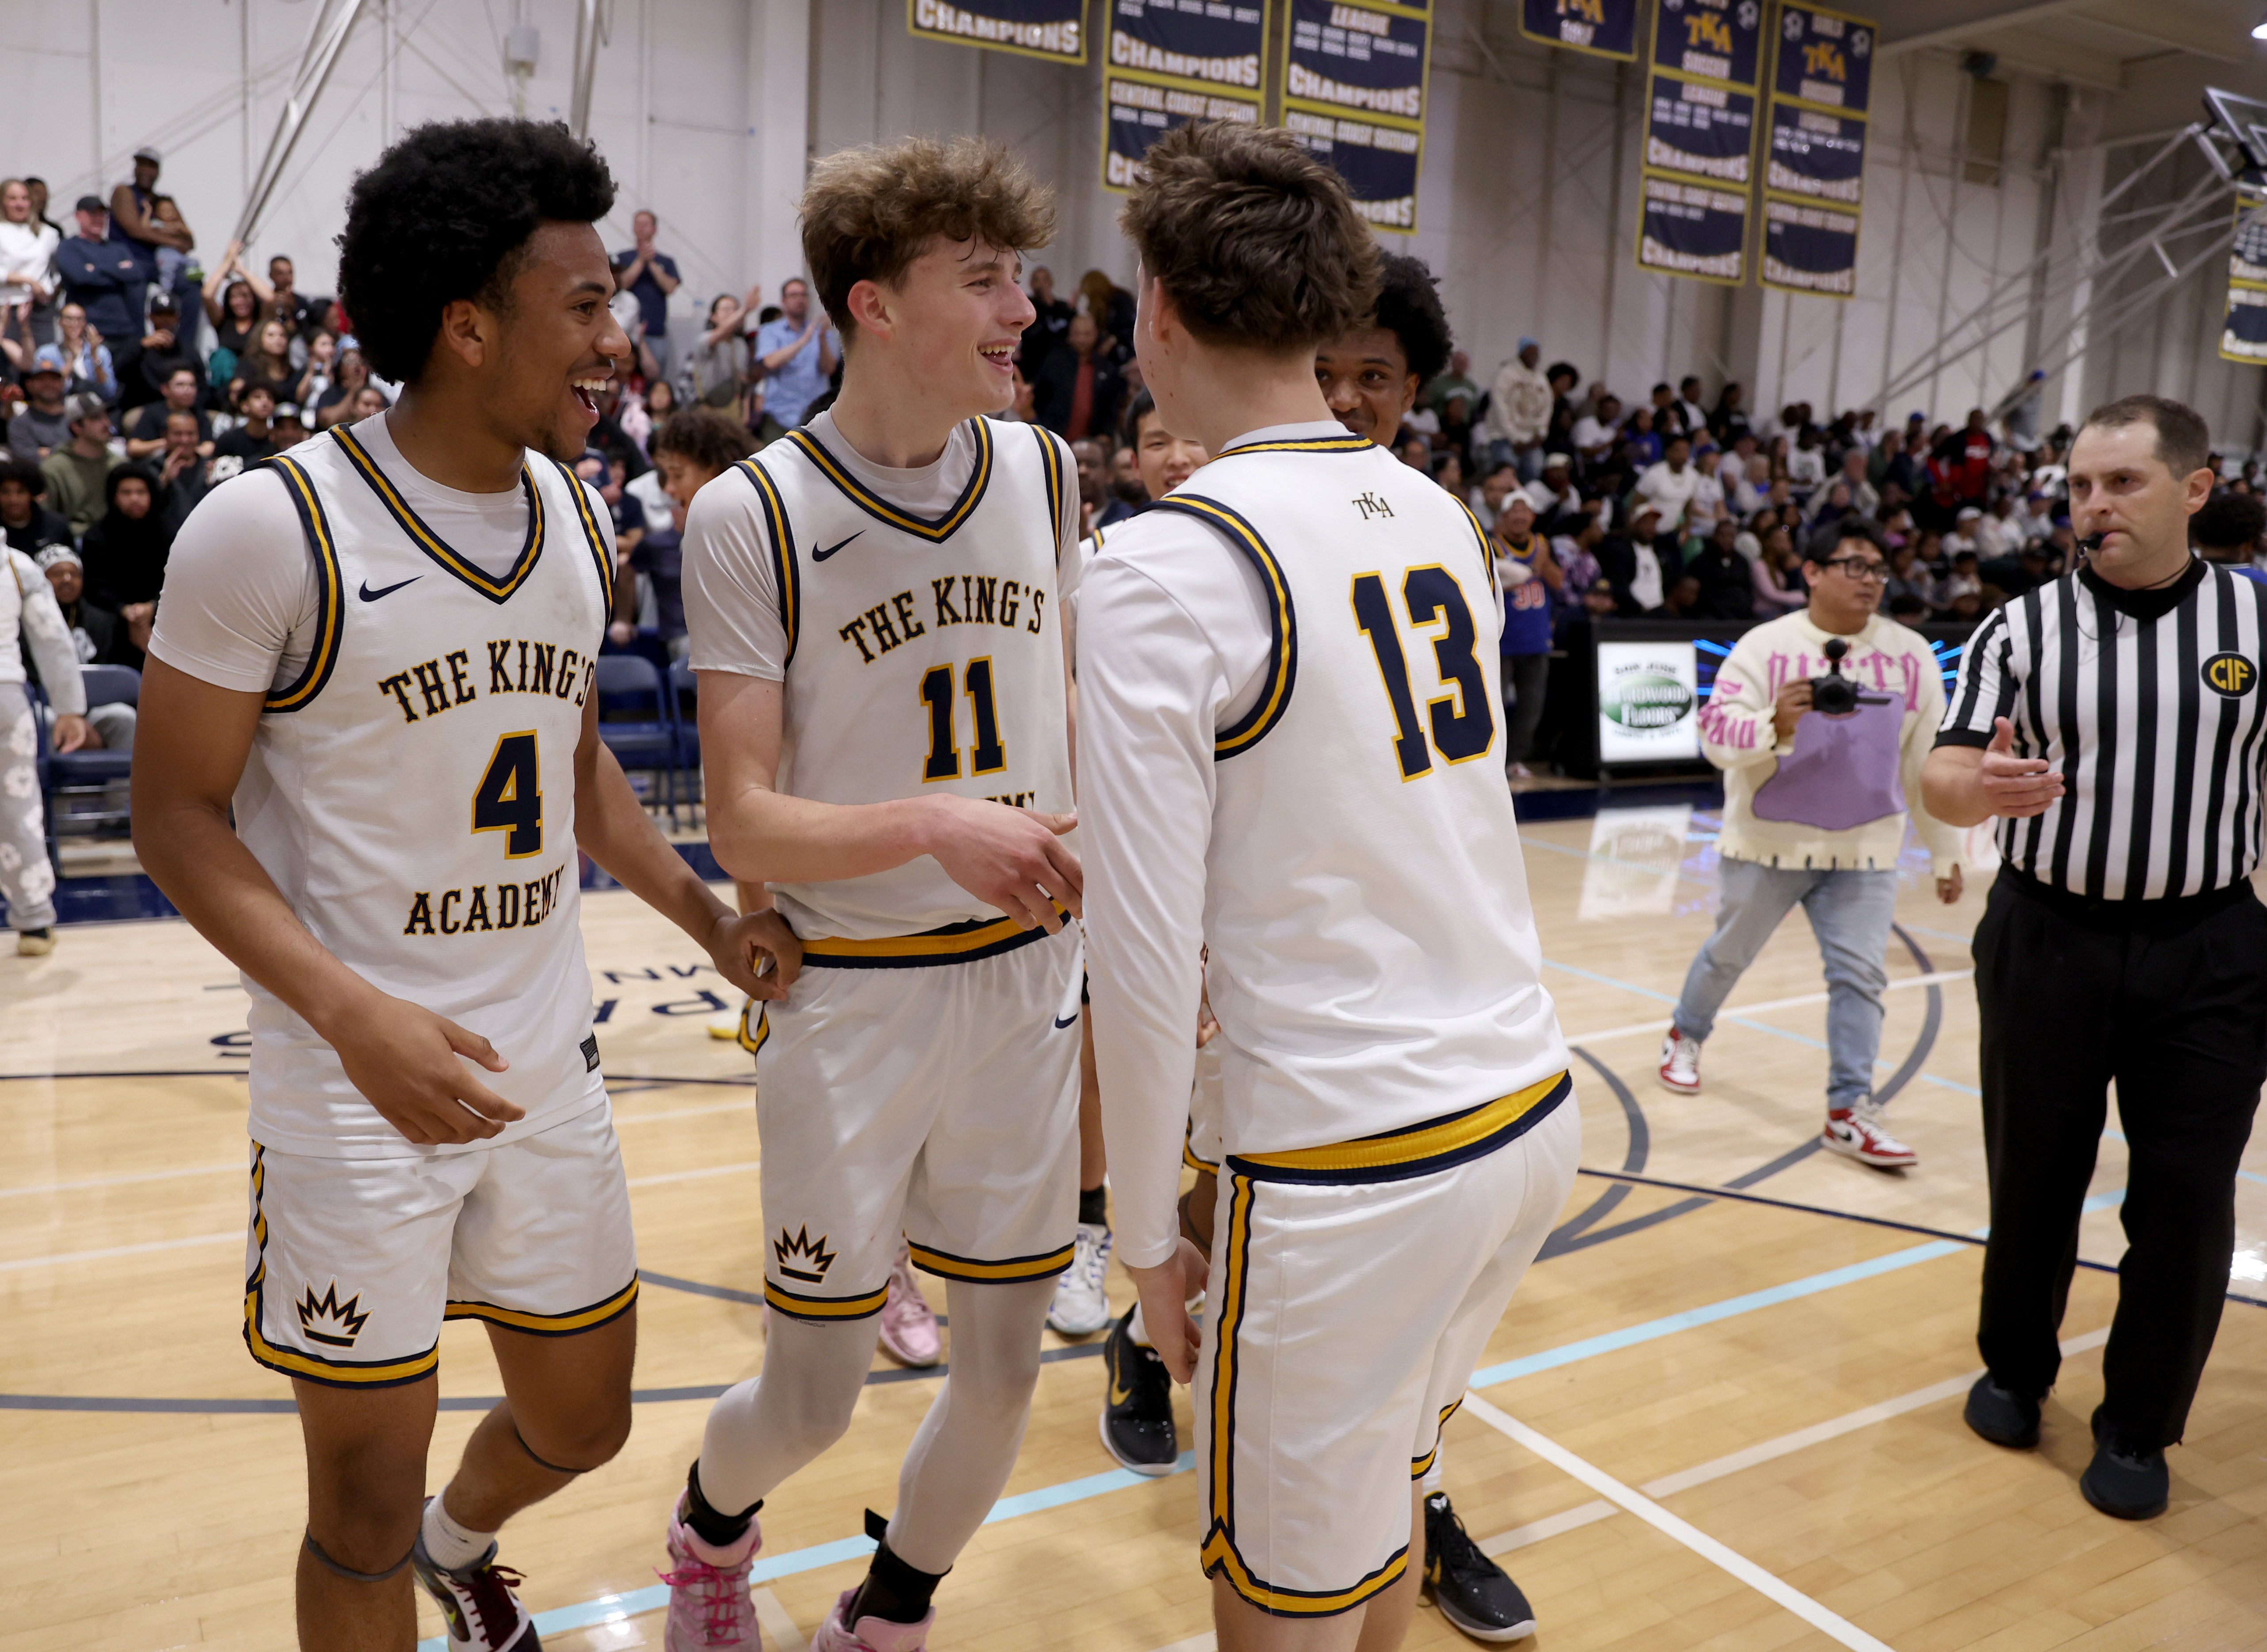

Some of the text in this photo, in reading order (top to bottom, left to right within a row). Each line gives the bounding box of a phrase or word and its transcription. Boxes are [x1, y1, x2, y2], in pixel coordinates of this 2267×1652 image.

[915, 0, 1081, 54] CHAMPIONS
[1330, 4, 1390, 37] LEAGUE
[1683, 12, 1734, 53] TKA
[1111, 29, 1260, 87] CHAMPIONS
[1802, 41, 1847, 82] TKA
[1288, 61, 1421, 116] CHAMPIONS
[1352, 491, 1395, 520] TKA
[838, 574, 1045, 665] THE KING'S
[1512, 580, 1546, 611] 30
[377, 638, 595, 724] THE KING'S
[1349, 562, 1496, 784] 13
[1768, 650, 1920, 711] DTO
[2209, 658, 2249, 691] CIF
[918, 655, 1007, 784] 11
[471, 729, 543, 860] 4
[403, 863, 565, 936] ACADEMY
